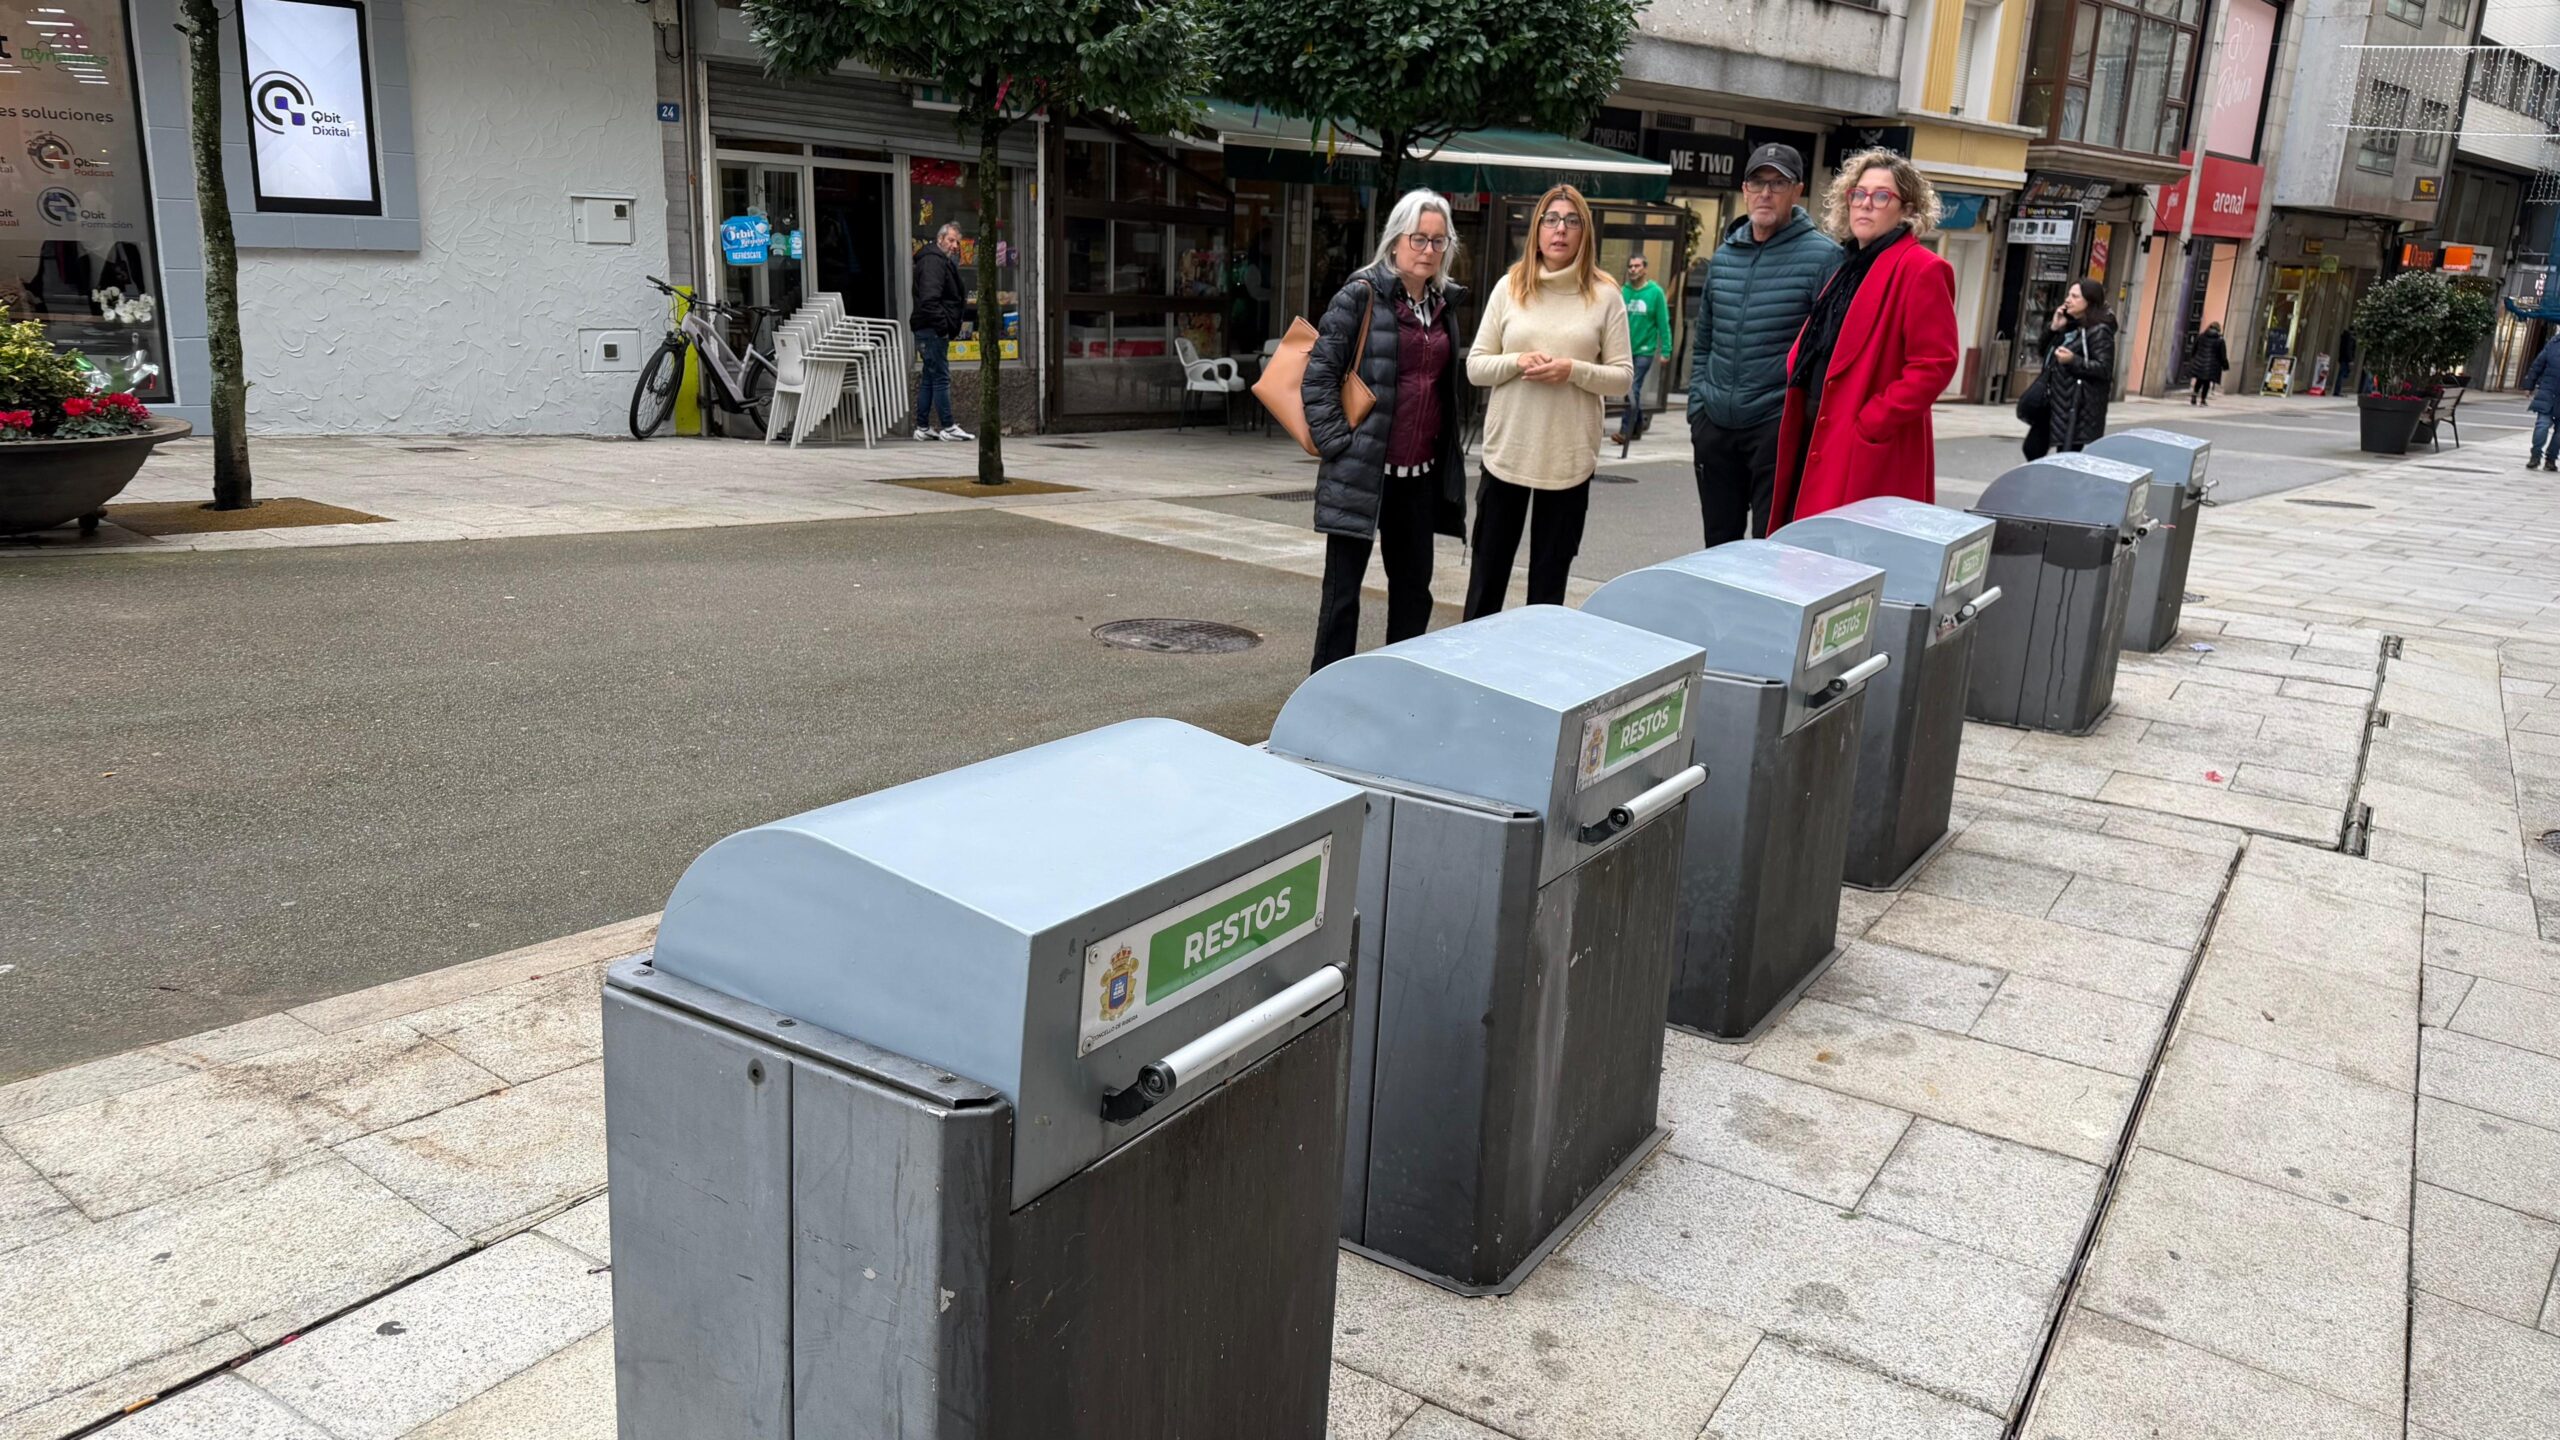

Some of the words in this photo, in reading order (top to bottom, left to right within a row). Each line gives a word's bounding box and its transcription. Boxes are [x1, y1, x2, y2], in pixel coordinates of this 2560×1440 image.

[21, 106, 114, 122] soluciones
[311, 111, 342, 124] Qbit
[662, 105, 674, 118] 24
[312, 126, 350, 137] Dixital
[1593, 127, 1637, 150] EMBLEMS
[73, 158, 101, 169] Qbit
[1670, 150, 1693, 171] ME
[1699, 153, 1735, 175] TWO
[74, 169, 114, 178] Podcast
[2213, 186, 2247, 215] arenal
[81, 210, 107, 220] Qbit
[727, 229, 754, 241] Orbit
[1833, 612, 1861, 642] RESTOS
[1620, 705, 1670, 749] RESTOS
[1183, 886, 1292, 969] RESTOS
